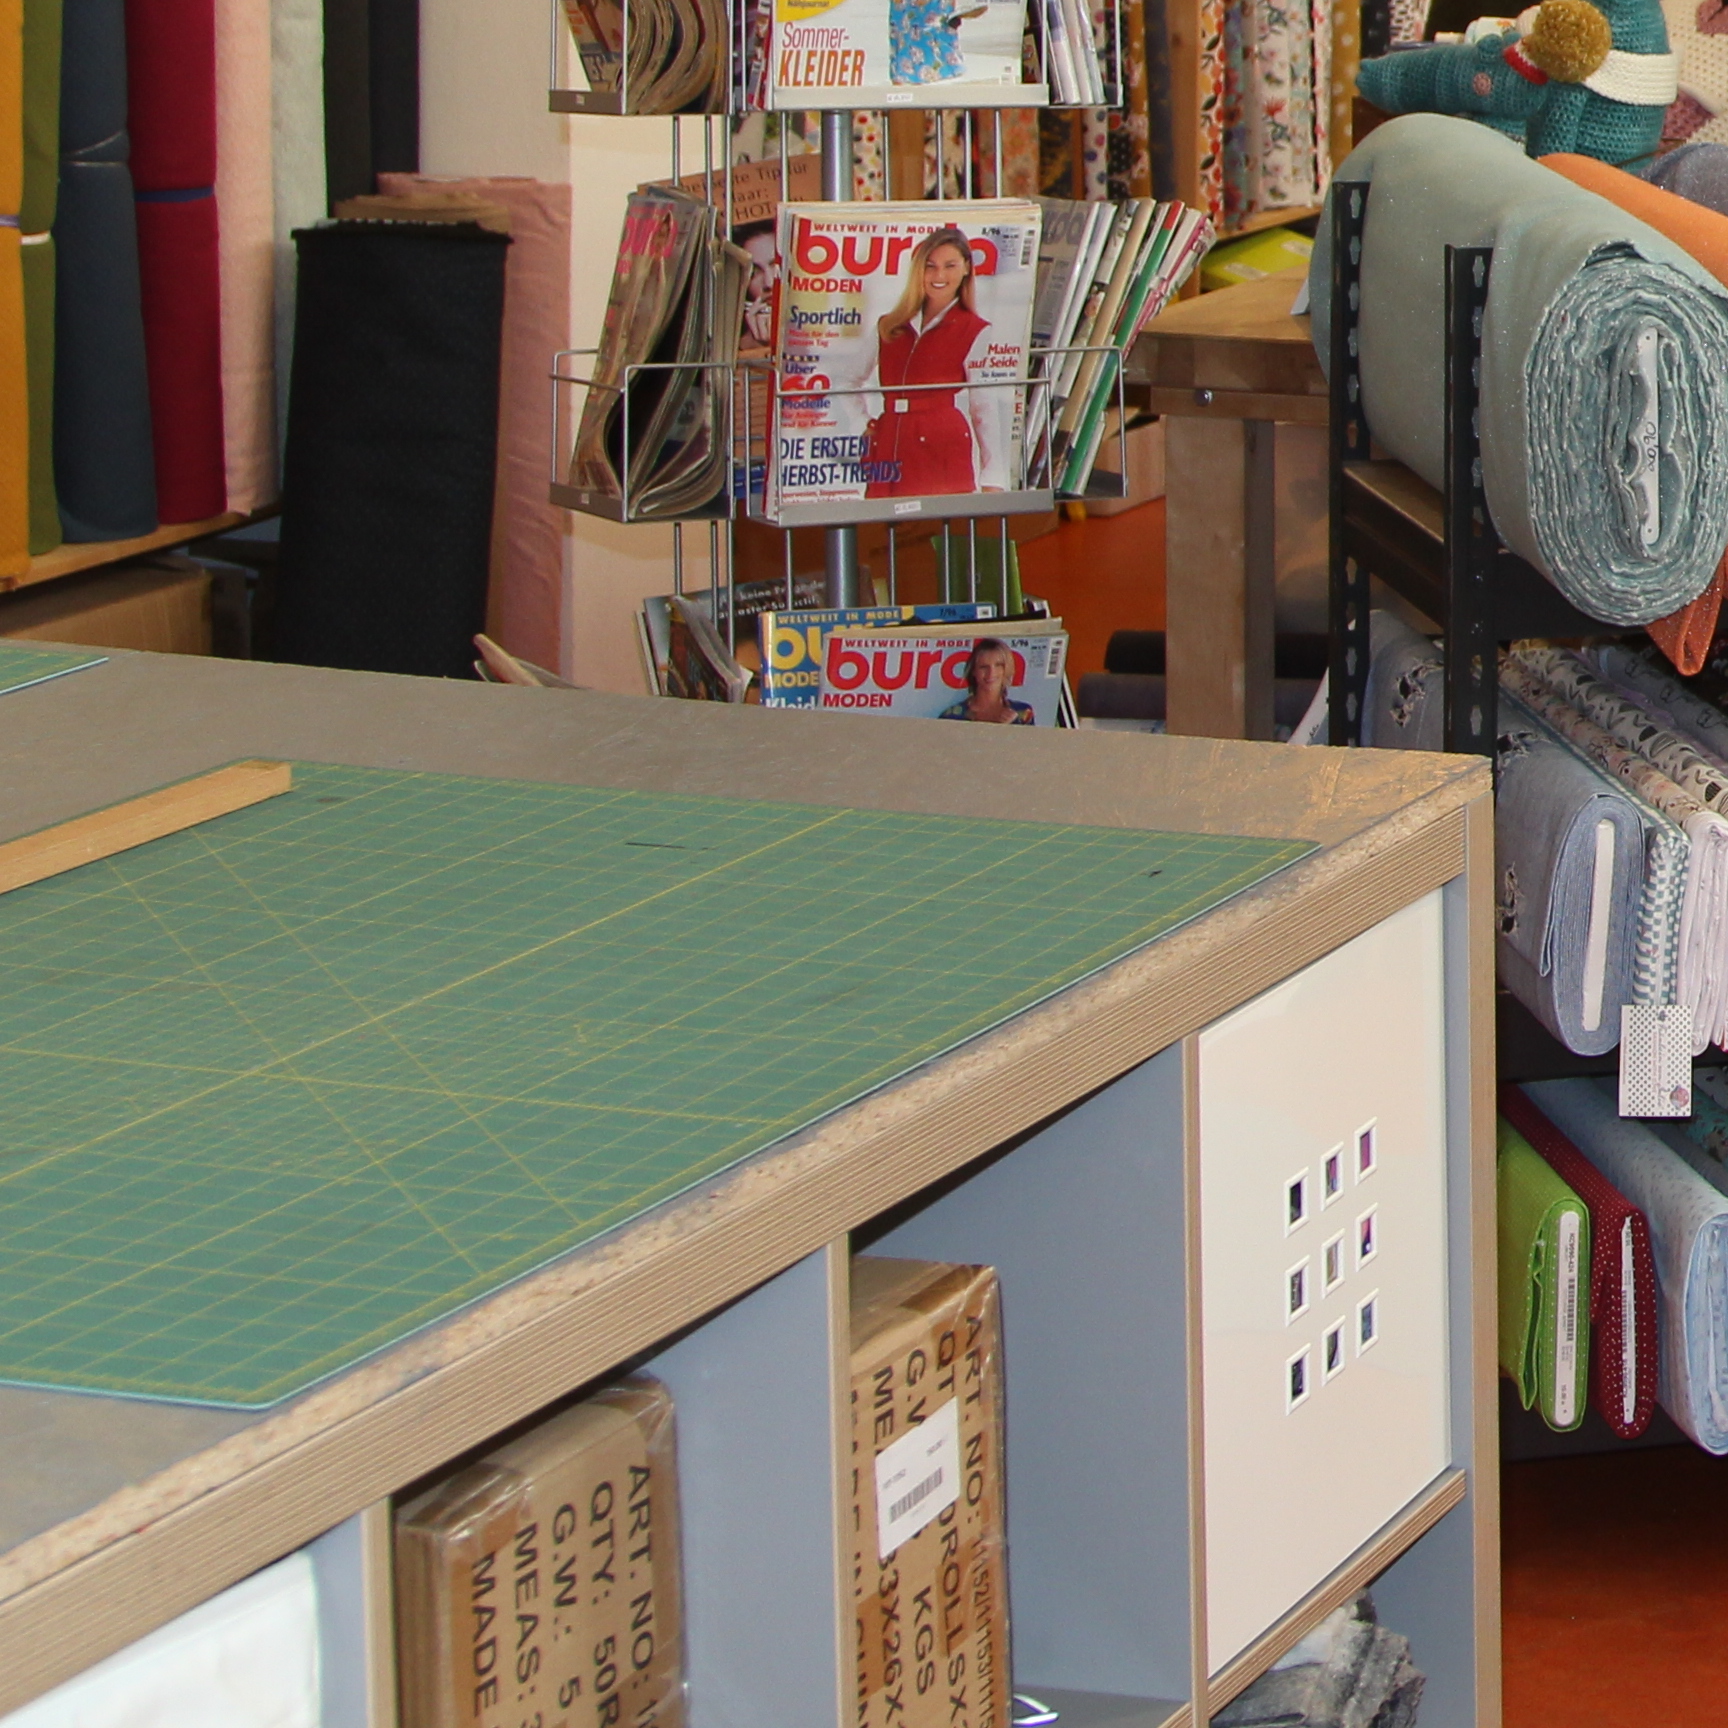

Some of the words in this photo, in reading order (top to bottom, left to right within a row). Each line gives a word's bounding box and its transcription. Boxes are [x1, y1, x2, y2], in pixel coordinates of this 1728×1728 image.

[782, 21, 850, 50] Sommer-
[778, 49, 866, 87] KLEIDER
[813, 223, 878, 234] WELTWEIT
[885, 224, 899, 234] IN
[792, 276, 863, 294] MODEN
[790, 305, 862, 330] Sportlich
[967, 357, 990, 370] auf
[991, 356, 1019, 368] Seide
[987, 343, 1022, 356] Malen
[780, 437, 805, 460] DIE
[810, 435, 871, 460] ERSTEN
[779, 460, 903, 488] HERBST-TRENDS
[776, 612, 840, 626] WELTWEIT
[844, 612, 860, 622] IN
[865, 610, 900, 621] MODE
[845, 638, 910, 649] WELTWEIT
[915, 638, 930, 648] IN
[935, 638, 972, 649] MODE
[764, 672, 820, 689] MODE
[823, 692, 893, 709] MODEN
[937, 1330, 956, 1393] QT
[965, 1317, 982, 1422] ART.
[965, 1431, 984, 1524] NO:
[628, 1464, 653, 1581] ART.
[589, 1480, 616, 1606] QTY:
[513, 1522, 542, 1704] MEAS:
[471, 1551, 499, 1719] MADE
[629, 1590, 655, 1690] NO:
[913, 1585, 936, 1697] KGS
[558, 1676, 582, 1709] 5
